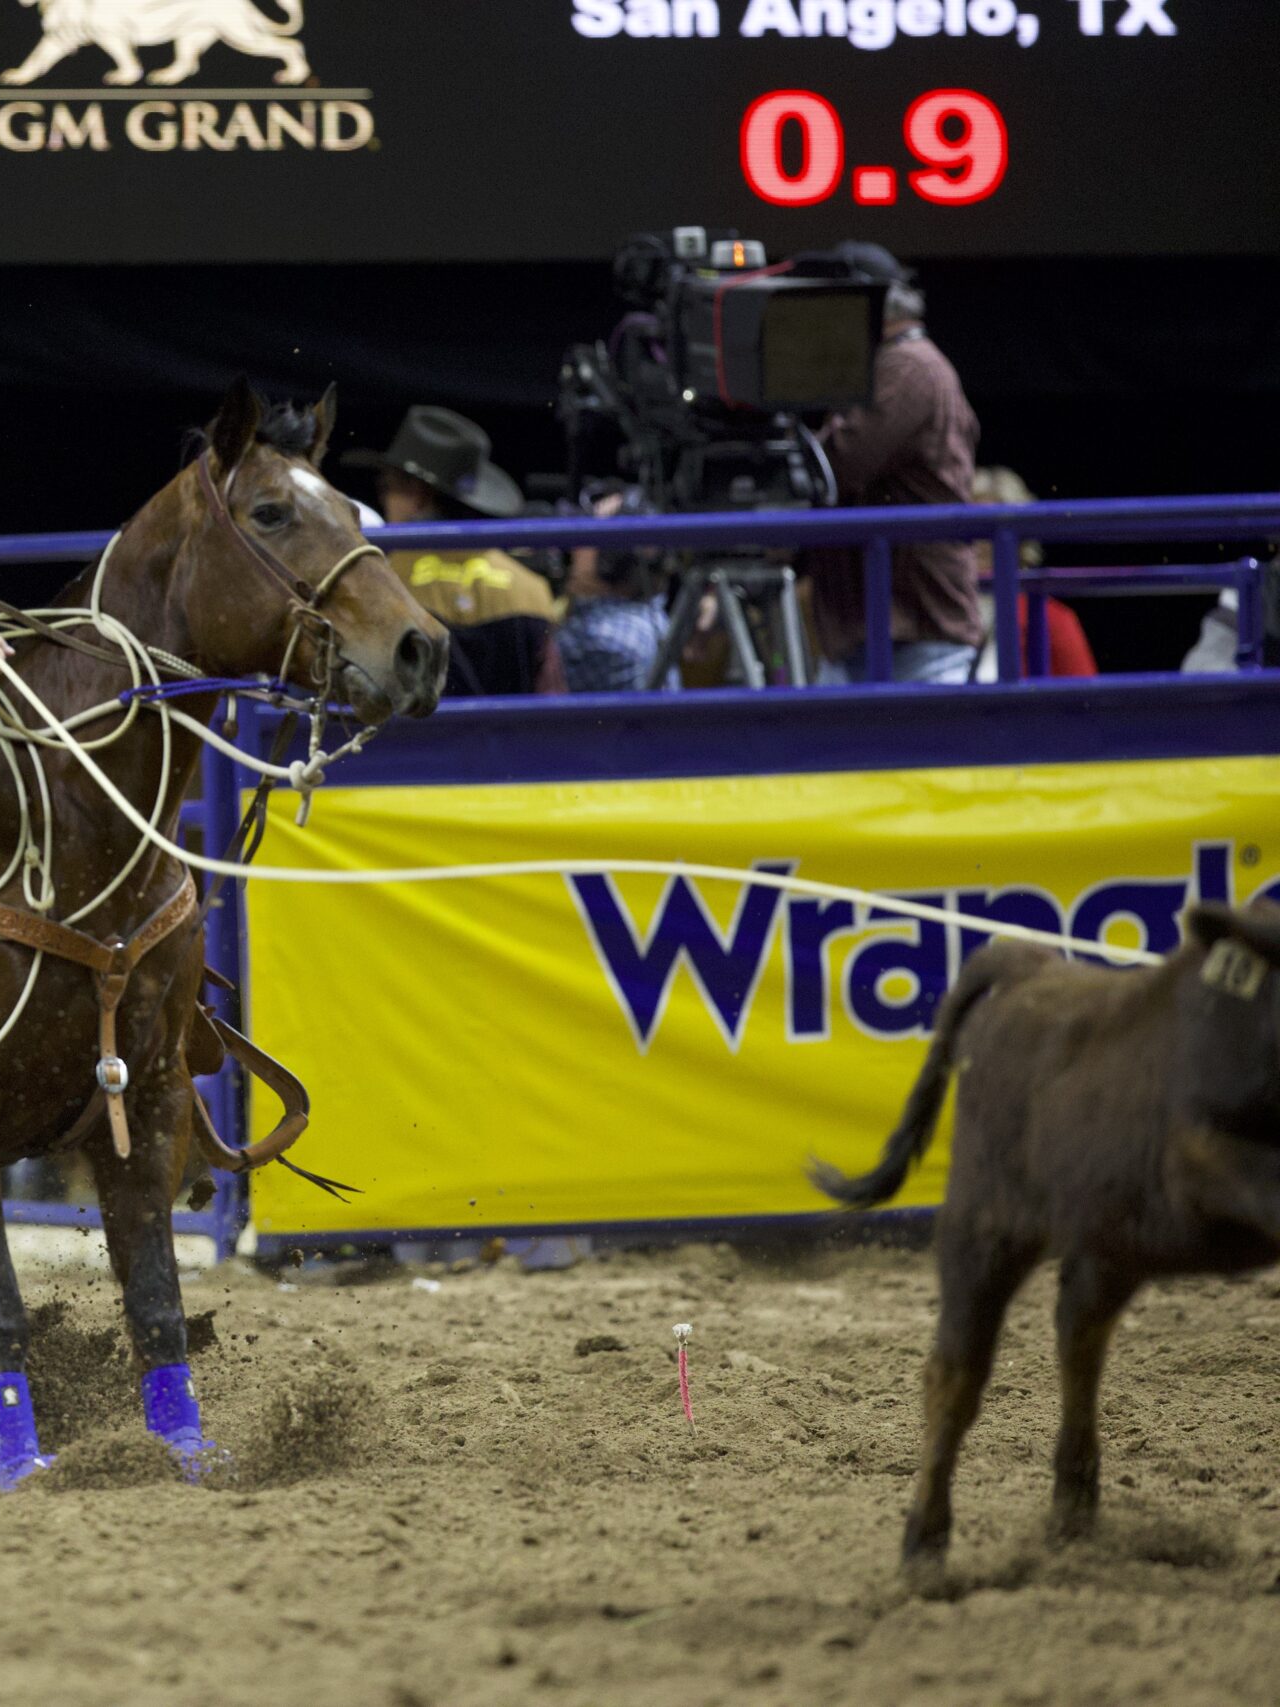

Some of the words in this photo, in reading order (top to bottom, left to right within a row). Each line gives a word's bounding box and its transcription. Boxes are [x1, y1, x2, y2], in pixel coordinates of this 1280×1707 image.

[571, 0, 720, 38] San
[739, 0, 1040, 49] Angelo,
[1073, 0, 1177, 37] TX
[124, 100, 375, 152] GRAND
[739, 88, 1010, 207] 0.9
